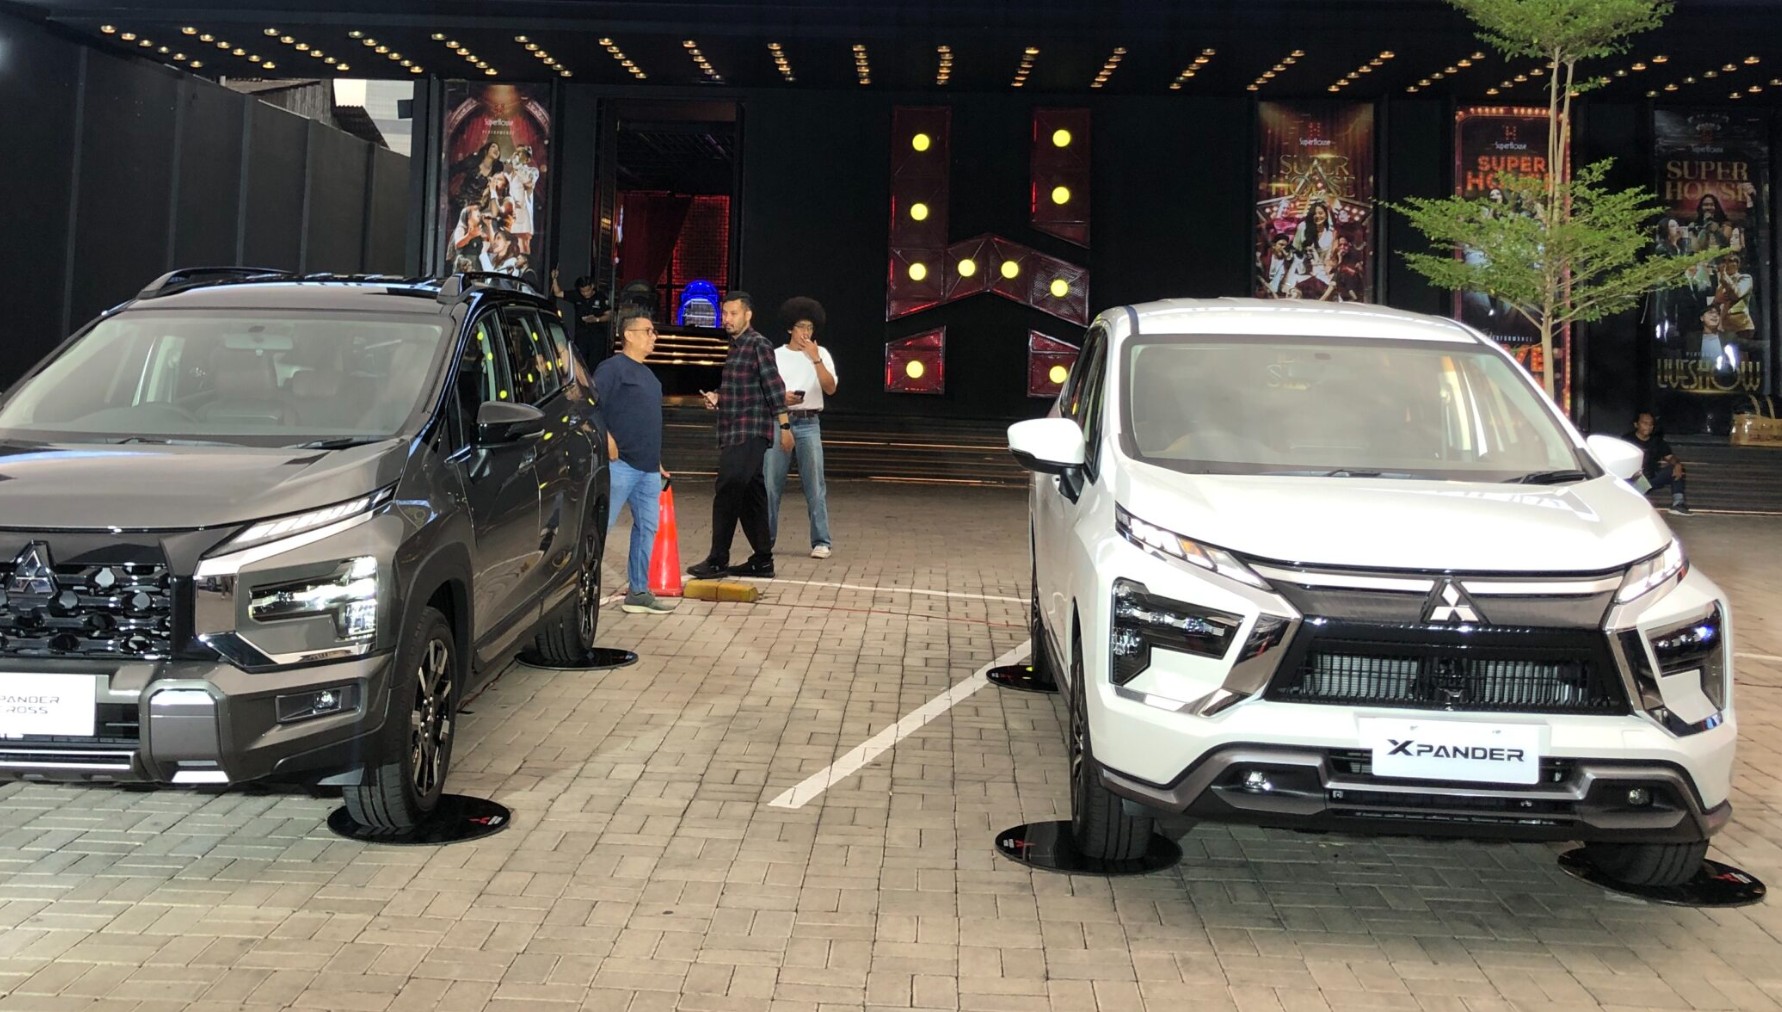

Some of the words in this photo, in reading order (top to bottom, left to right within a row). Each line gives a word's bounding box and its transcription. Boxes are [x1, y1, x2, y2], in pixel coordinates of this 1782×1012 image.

[1478, 155, 1546, 172] SUPER
[1666, 160, 1749, 181] SUPER
[0, 705, 49, 715] ROSS
[1386, 738, 1524, 762] XPANDER
